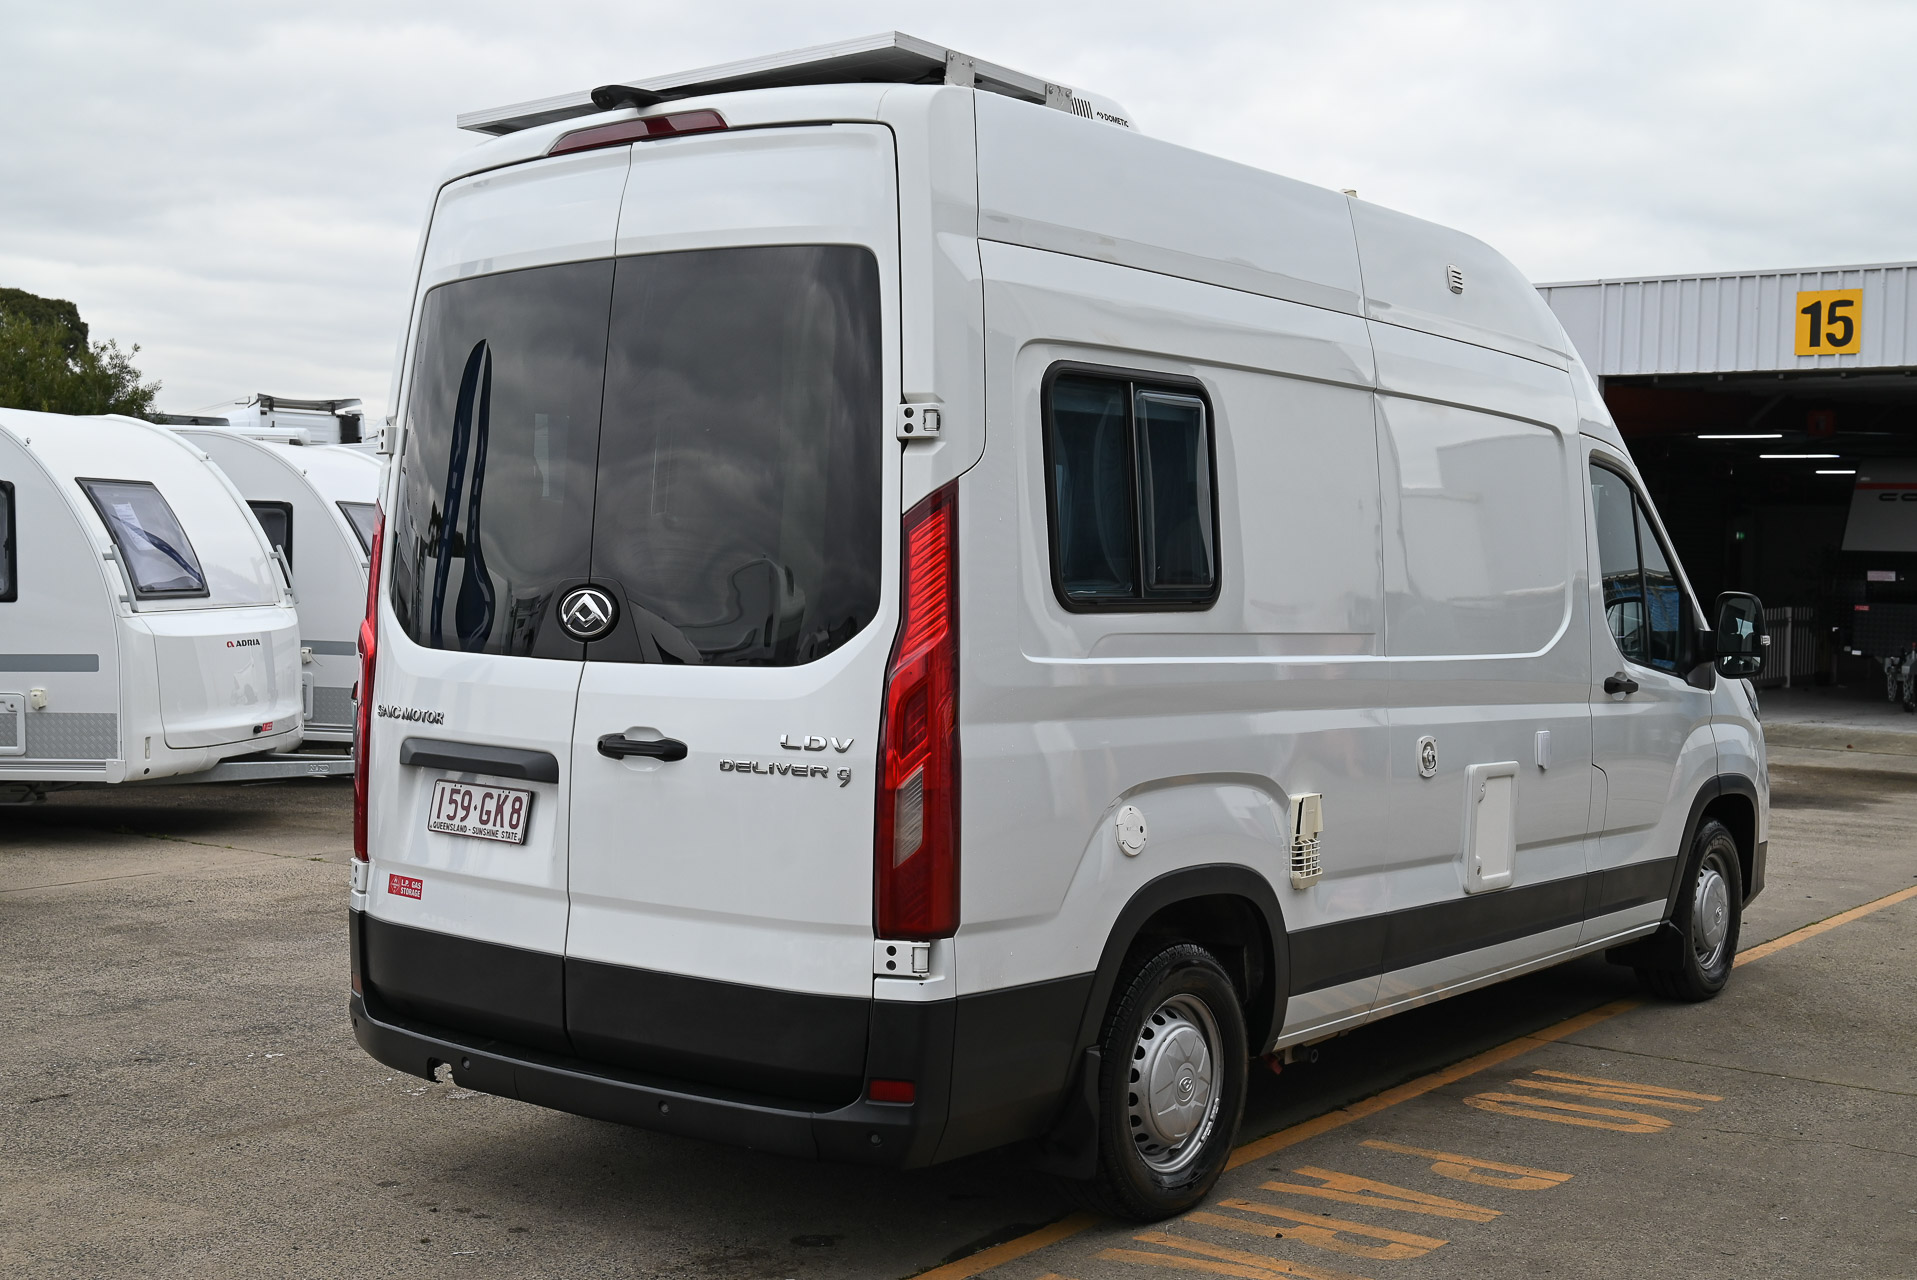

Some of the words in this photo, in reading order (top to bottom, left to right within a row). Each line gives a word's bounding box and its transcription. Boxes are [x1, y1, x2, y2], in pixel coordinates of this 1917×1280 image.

[1104, 113, 1129, 127] DOMETIC
[1801, 300, 1854, 347] 15
[236, 639, 260, 647] ADRIA
[402, 707, 444, 725] MOTOR
[780, 734, 854, 753] LDV
[720, 759, 829, 778] DELIVER
[837, 766, 851, 788] 9
[433, 821, 467, 833] QUEENSLAND
[472, 826, 499, 838] SUNSHINE
[501, 831, 518, 841] STATE
[400, 887, 421, 897] STORAGE
[412, 881, 421, 889] GAS
[1461, 1068, 1725, 1134] NO
[1036, 1139, 1575, 1280] PARK
